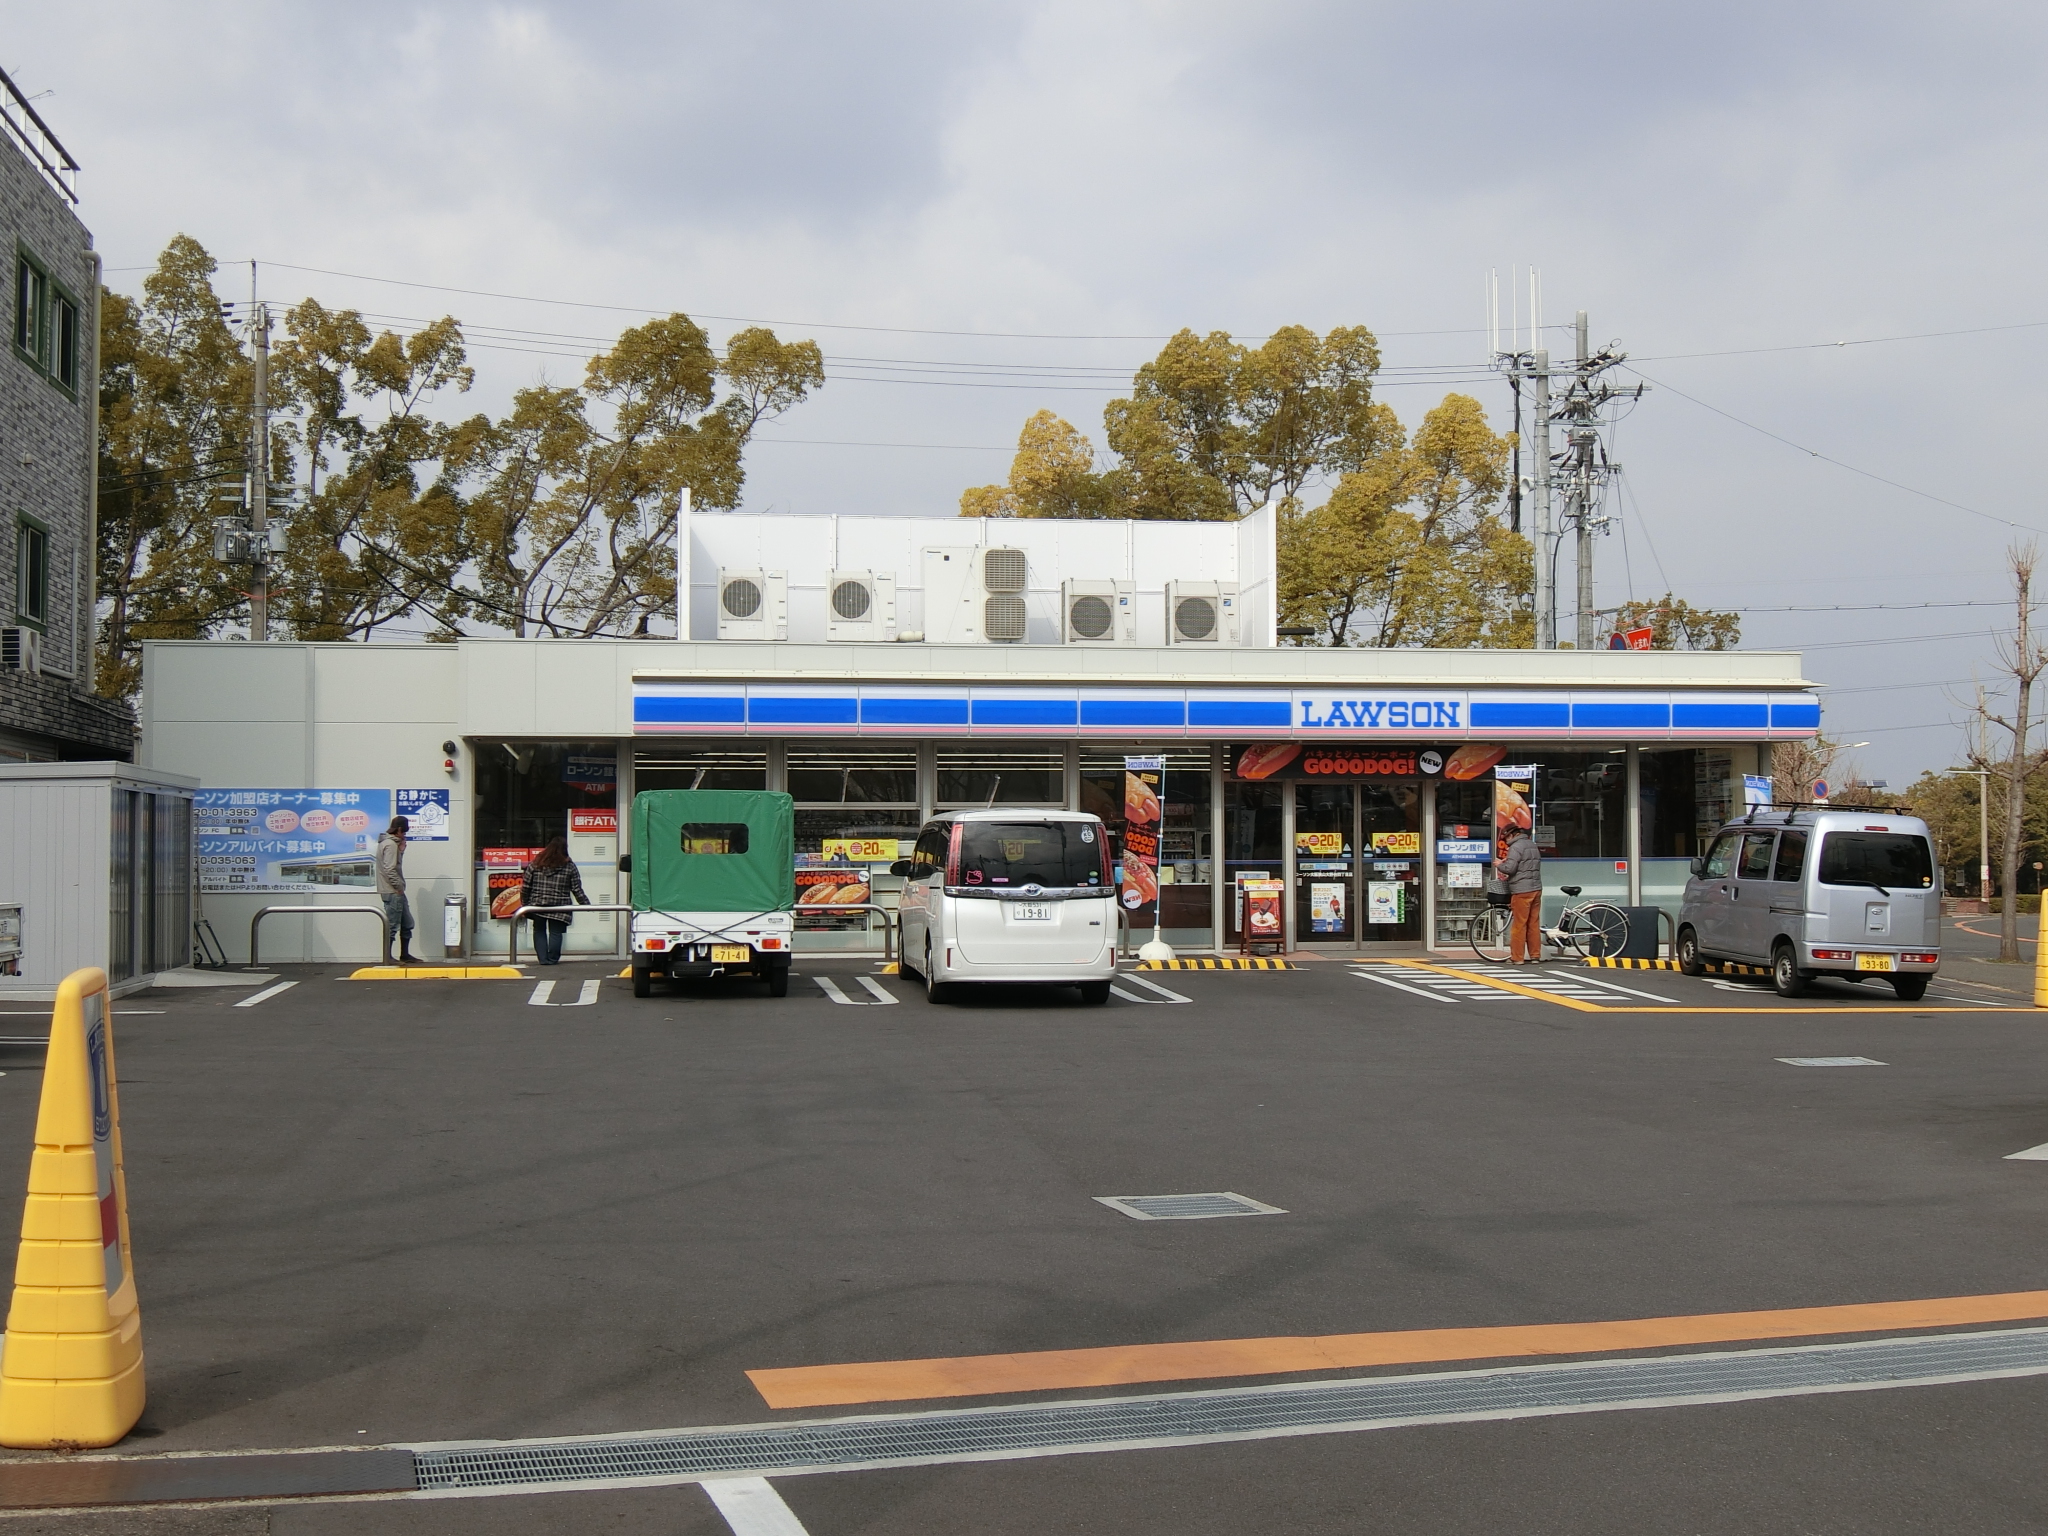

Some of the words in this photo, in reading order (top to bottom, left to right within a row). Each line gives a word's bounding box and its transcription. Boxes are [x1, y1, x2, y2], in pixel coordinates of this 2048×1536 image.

[1301, 701, 1460, 727] LAWSON
[1303, 758, 1416, 775] GOOODOG!
[1420, 756, 1442, 768] NEW
[566, 765, 616, 777] ローソン銀
[585, 783, 606, 792] ATM
[1442, 843, 1485, 852] ローソン銀行
[795, 873, 859, 886] GOOODOG!
[1022, 908, 1047, 918] 19-81
[720, 950, 746, 961] 71-41
[1865, 960, 1890, 970] 93-80
